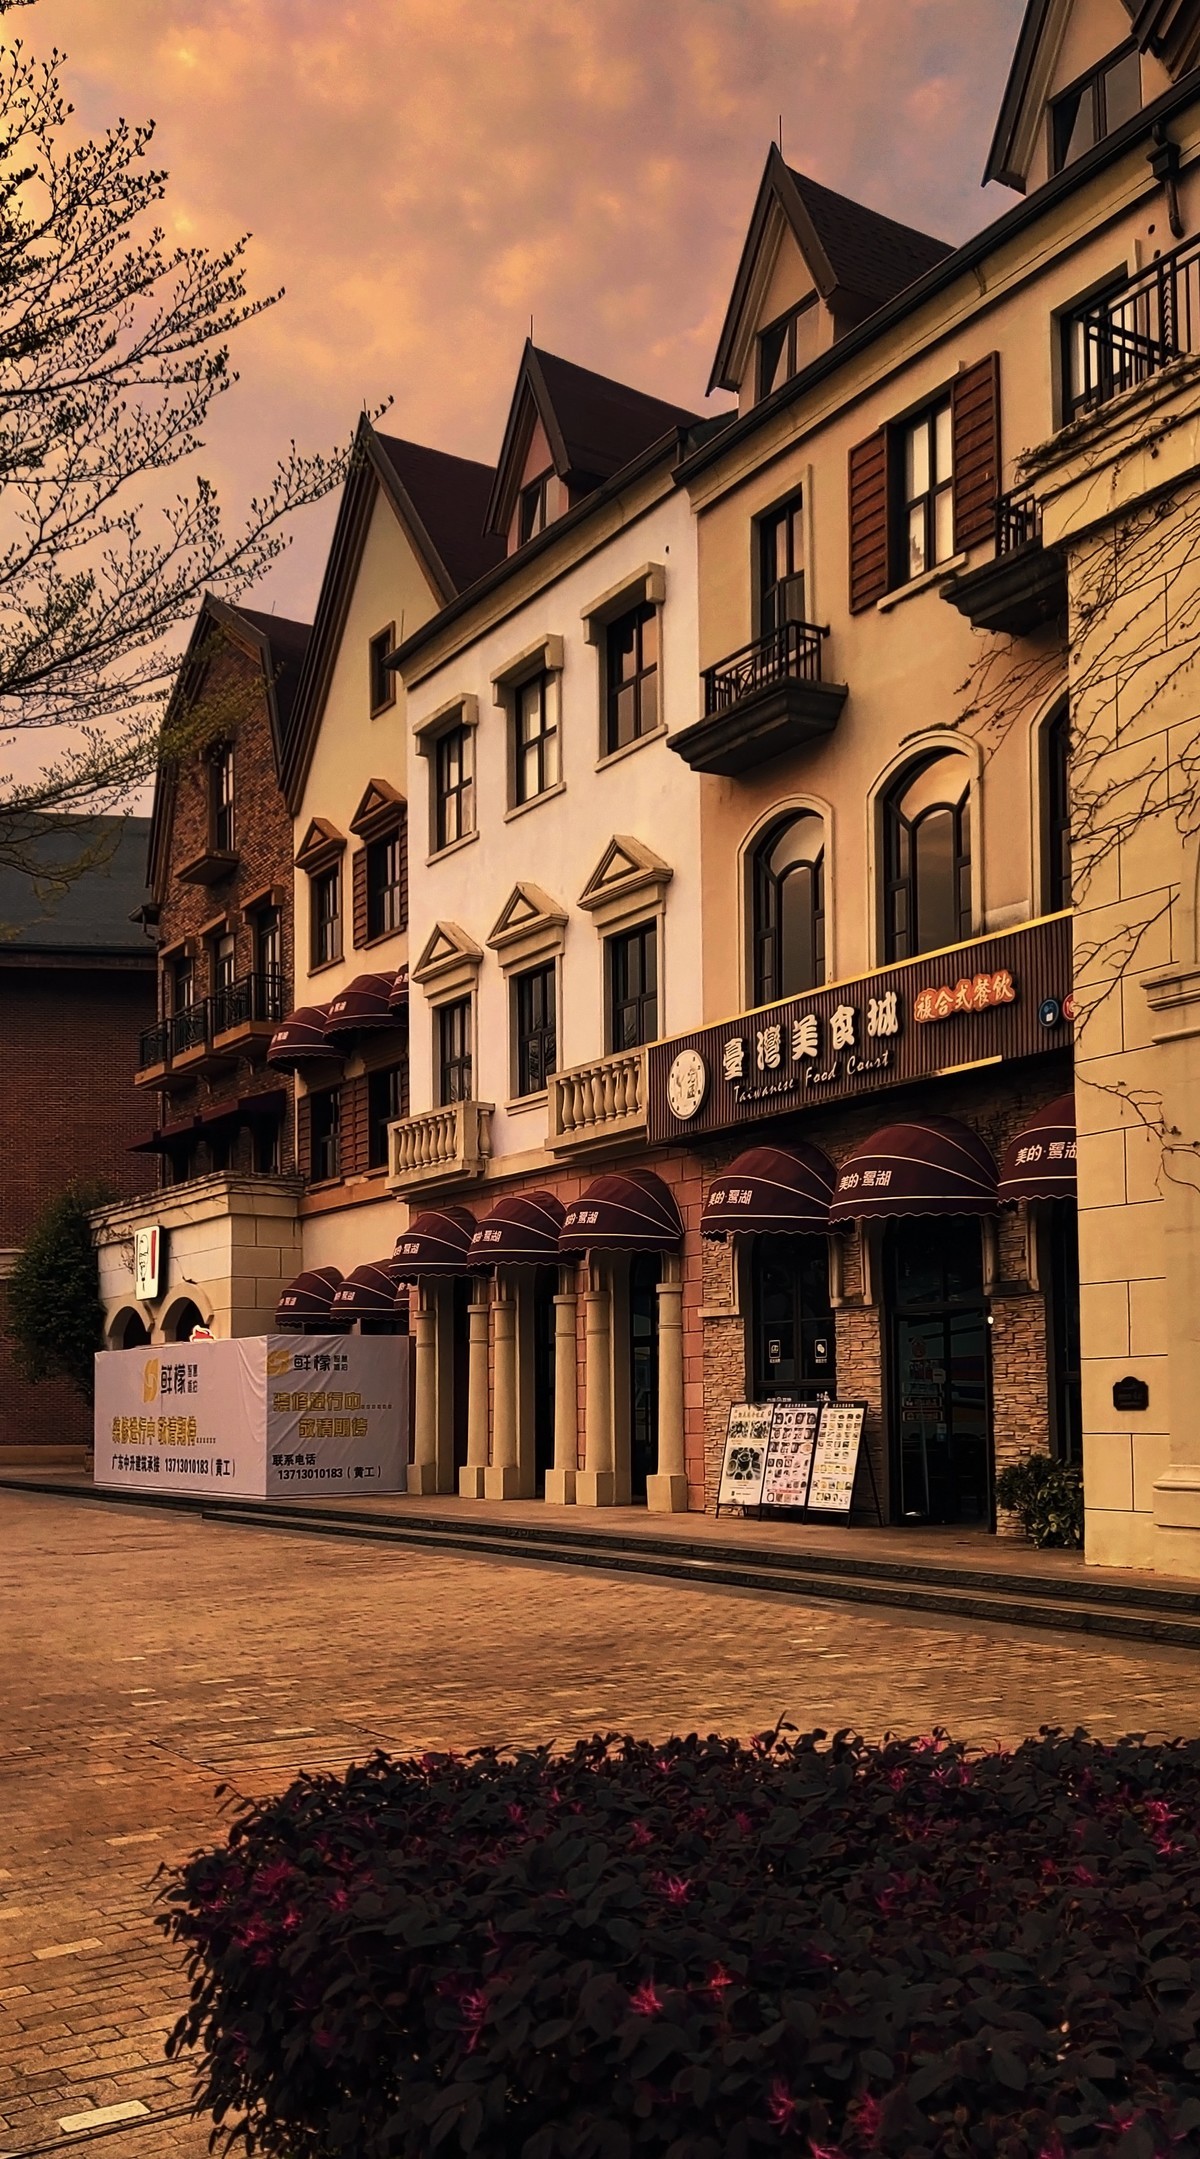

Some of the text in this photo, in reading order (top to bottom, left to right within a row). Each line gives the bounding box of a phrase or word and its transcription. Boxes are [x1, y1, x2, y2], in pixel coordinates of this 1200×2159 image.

[722, 991, 898, 1081] 臺灣美食城
[733, 1049, 890, 1104] Taiwanese Food Court
[298, 1417, 368, 1438] 敬请期待
[272, 1453, 316, 1467] 联系电话
